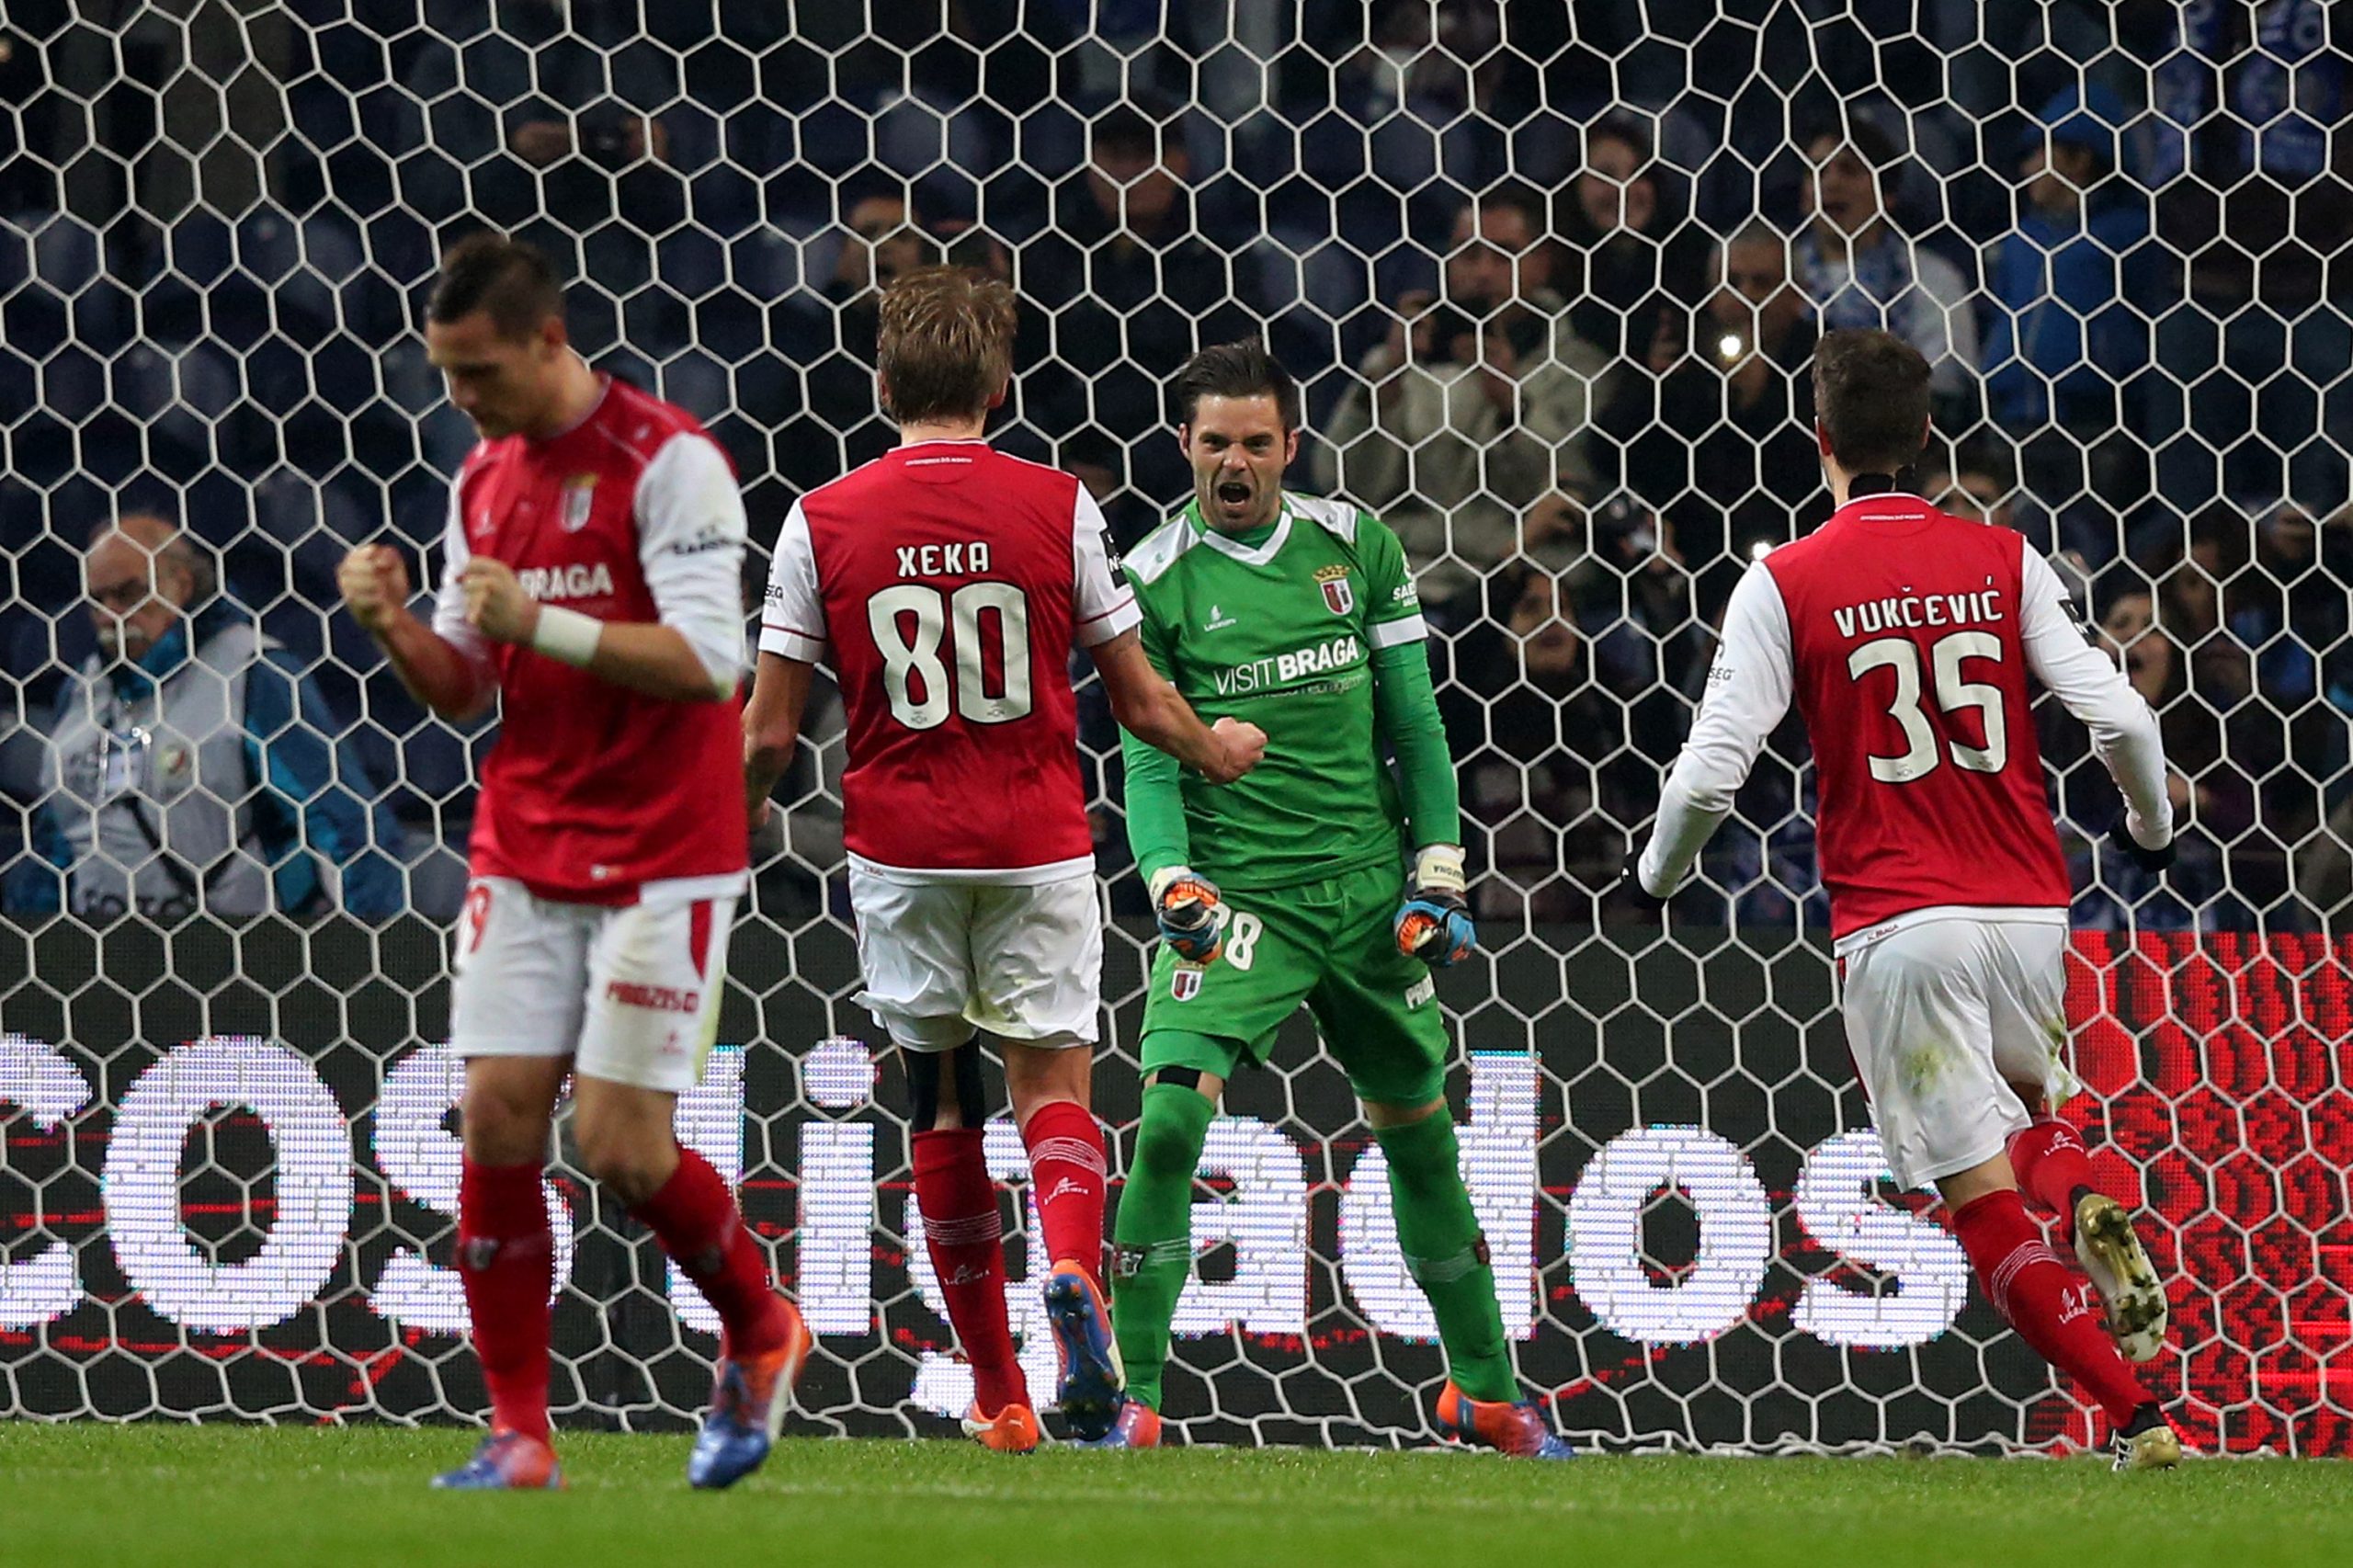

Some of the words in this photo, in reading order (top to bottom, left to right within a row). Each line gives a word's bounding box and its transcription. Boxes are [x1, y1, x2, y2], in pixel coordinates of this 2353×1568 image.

[896, 541, 989, 577] XEKA
[1834, 575, 2004, 638] VUKČEVIĆ
[867, 581, 1033, 730] 80
[1213, 658, 1275, 696] VISIT
[1277, 635, 1359, 682] BRAGA
[1847, 631, 2007, 784] 35
